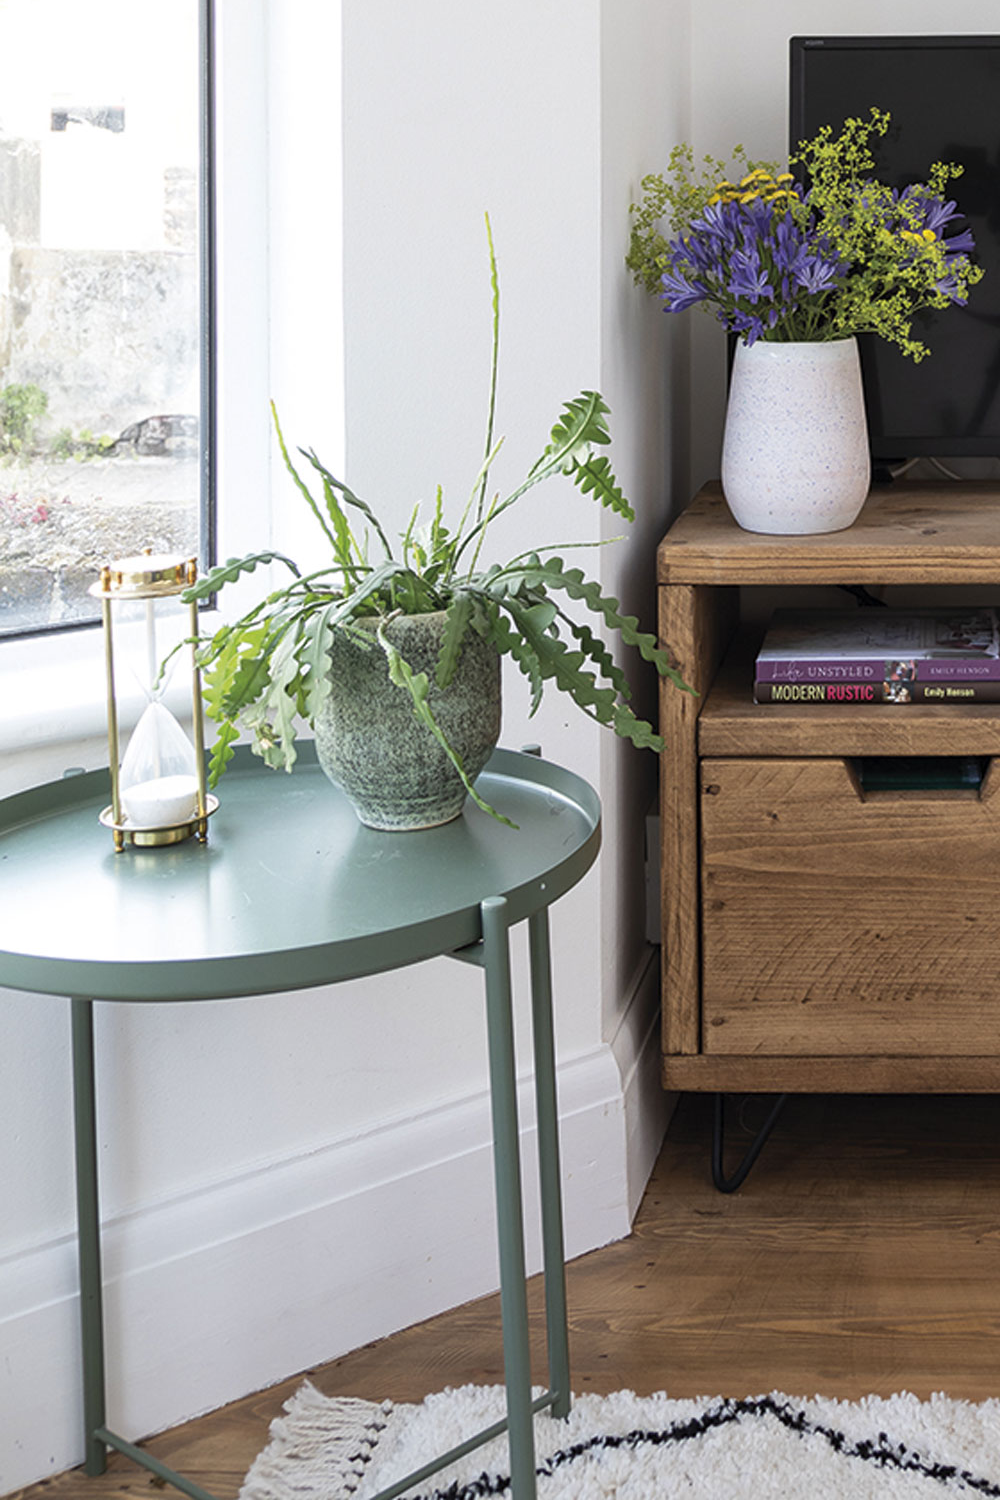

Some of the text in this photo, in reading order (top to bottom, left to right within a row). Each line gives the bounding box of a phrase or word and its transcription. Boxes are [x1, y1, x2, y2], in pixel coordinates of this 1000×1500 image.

[808, 666, 874, 678] UNSTYLED
[957, 666, 990, 675] HENSON
[771, 685, 874, 700] MODERN RUSTIC
[924, 686, 945, 699] Emily
